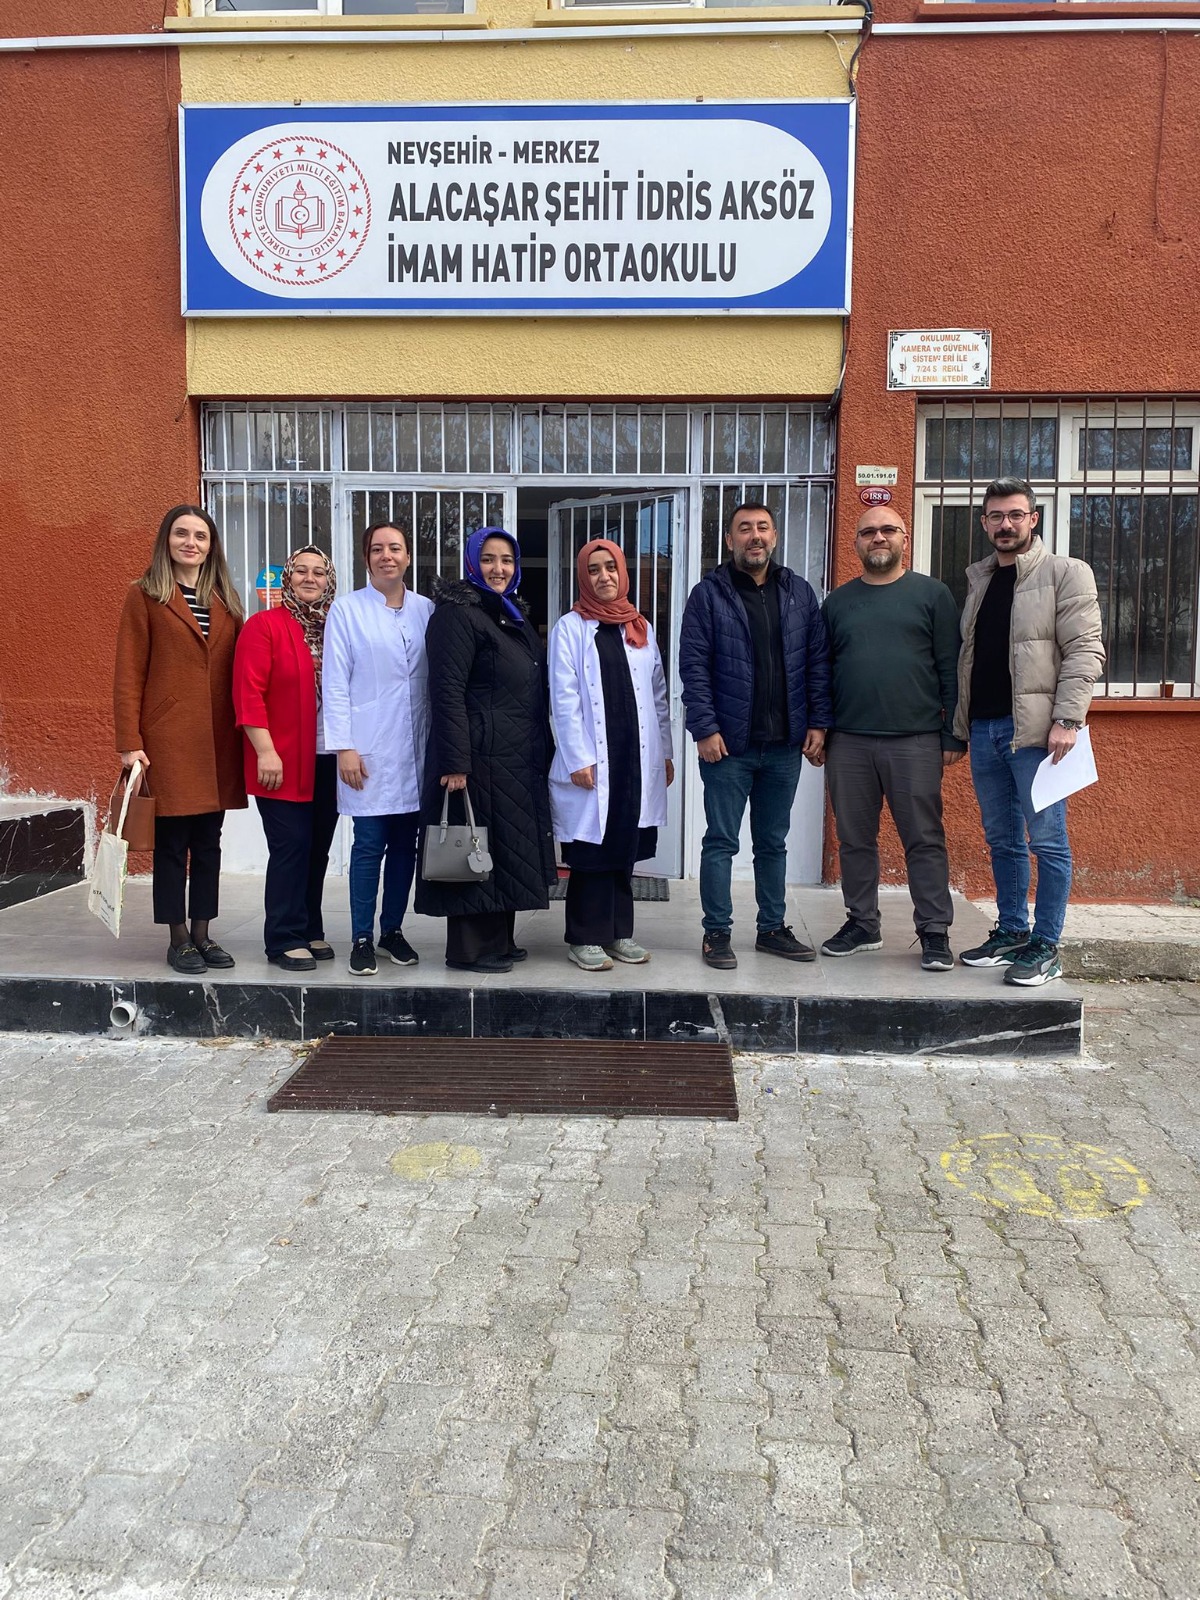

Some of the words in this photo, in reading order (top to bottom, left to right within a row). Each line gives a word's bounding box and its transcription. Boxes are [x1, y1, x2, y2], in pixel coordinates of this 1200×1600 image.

[388, 135, 493, 167] NEVŞEHİR
[513, 141, 600, 164] MERKEZ
[297, 163, 325, 177] MİLLİ
[255, 163, 294, 222] CUMHURİYETİ
[324, 174, 345, 208] EĞİTİM
[388, 181, 540, 227] ALACAŞAR
[544, 170, 629, 226] ŞEHİT
[637, 169, 712, 221] İDRİS
[719, 168, 815, 220] AKSÖZ
[310, 211, 346, 257] BAKANLIĞI
[387, 232, 462, 283] İMAM
[472, 232, 557, 283] HATİP
[564, 242, 737, 282] ORTAOKULU
[920, 334, 961, 342] OKULUMUZ
[942, 343, 980, 352] GÜVENLİK
[932, 364, 964, 373] SREKLİ
[956, 354, 968, 362] İLE
[911, 374, 969, 383] İZLENMKTEDİR
